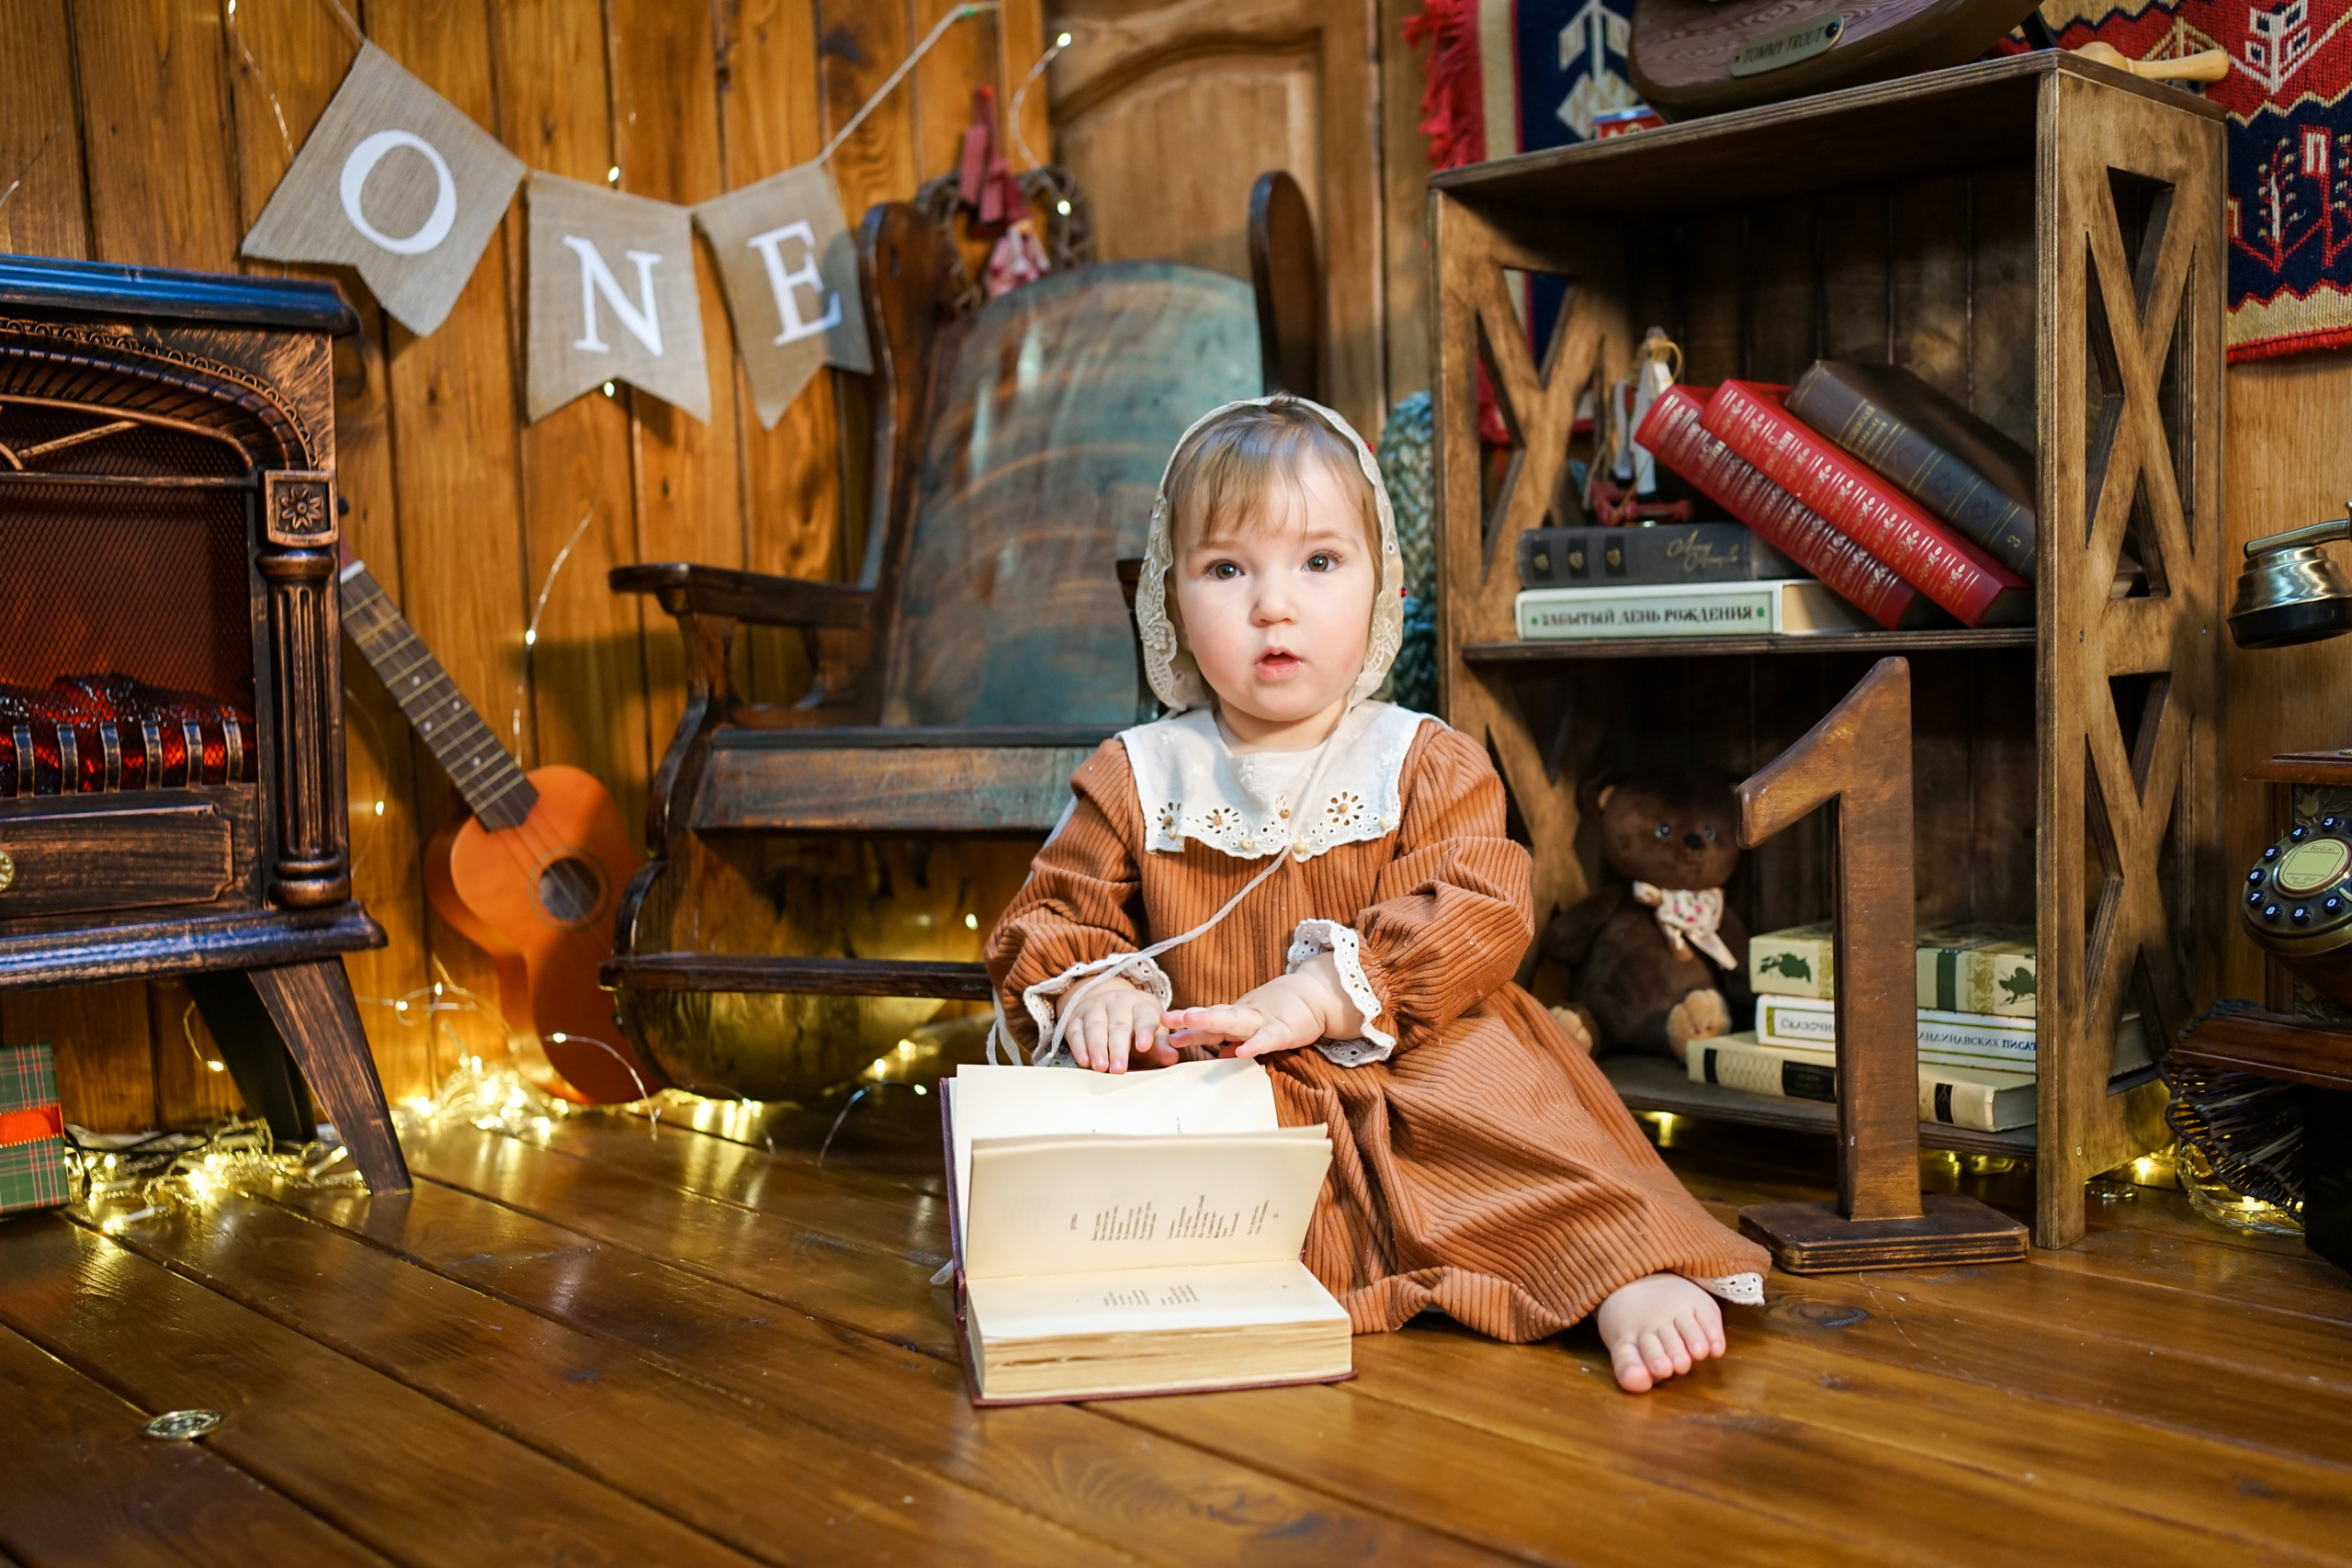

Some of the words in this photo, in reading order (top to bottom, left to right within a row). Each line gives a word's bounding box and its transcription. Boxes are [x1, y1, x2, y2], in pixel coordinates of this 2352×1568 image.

[1743, 39, 1782, 64] TOMMY
[1787, 27, 1825, 51] TROUT
[340, 130, 841, 356] ONE
[2008, 534, 2022, 548] 3
[1543, 608, 1614, 626] ЗАБЫТЫЙ
[1619, 609, 1660, 625] ДЕНЬ
[1664, 606, 1753, 624] РОЖДЕНИЯ
[2324, 818, 2334, 826] 3
[2265, 849, 2275, 857] 5
[2250, 893, 2259, 901] 7
[2327, 898, 2336, 907] 0
[2266, 907, 2276, 915] 8
[2294, 908, 2304, 917] 9
[1918, 1032, 1999, 1047] АНДИНАВСКИХ
[2002, 1040, 2036, 1051] ПИСАТ
